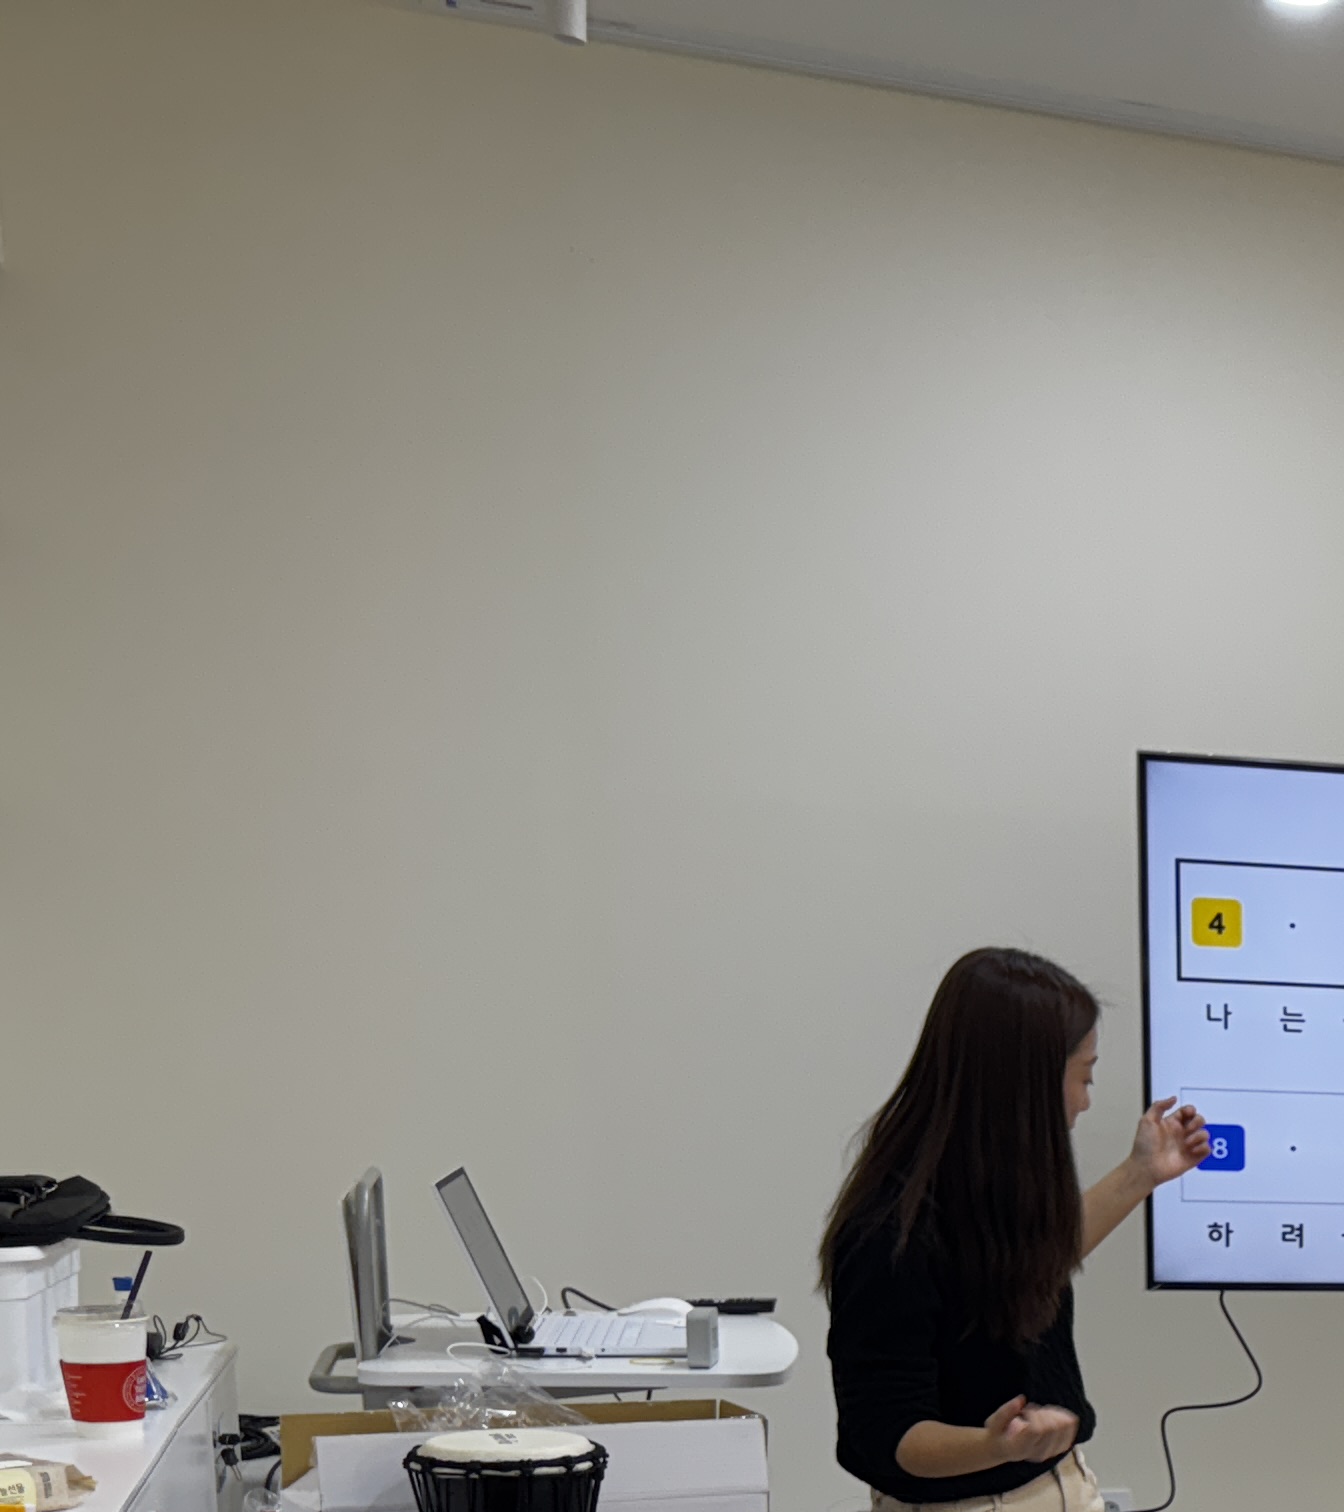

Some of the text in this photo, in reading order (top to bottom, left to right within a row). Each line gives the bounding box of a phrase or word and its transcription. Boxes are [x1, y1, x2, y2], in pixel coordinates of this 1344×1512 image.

[1208, 914, 1226, 935] 4
[1206, 1003, 1232, 1030] 나
[1279, 1006, 1306, 1033] 는
[1212, 1138, 1229, 1160] 8
[1207, 1221, 1234, 1248] 하
[1281, 1223, 1304, 1249] 려
